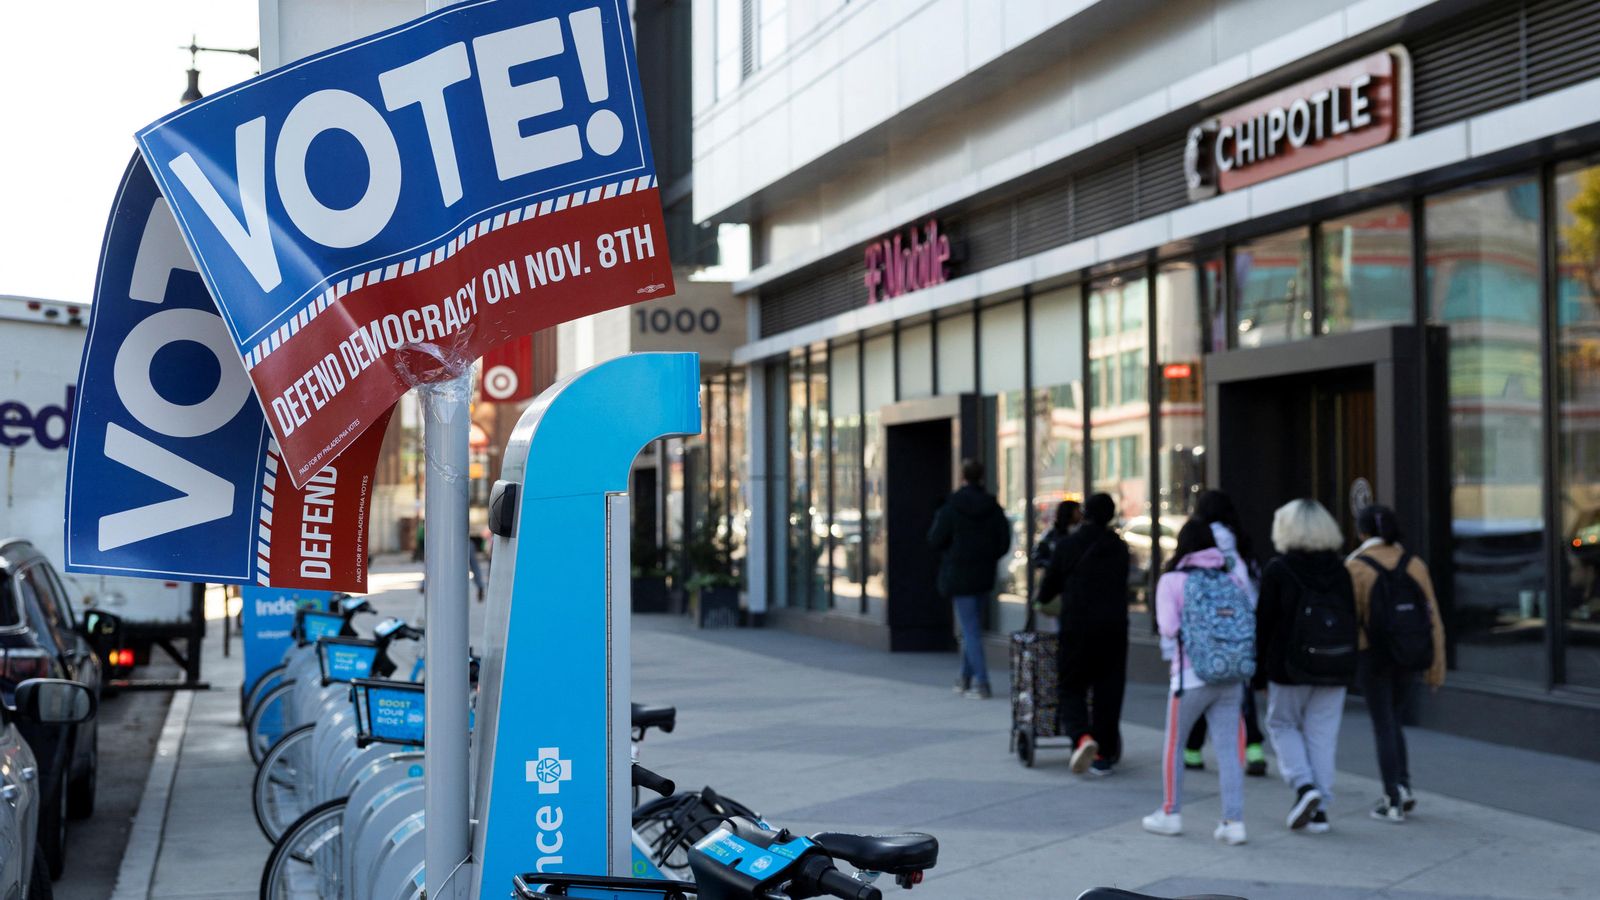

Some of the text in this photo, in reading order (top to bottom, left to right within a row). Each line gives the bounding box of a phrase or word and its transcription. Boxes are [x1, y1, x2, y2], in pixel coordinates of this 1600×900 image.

[168, 6, 624, 293] VOTE!
[1215, 74, 1371, 172] CHIPOTLE
[272, 224, 655, 437] DEFEND DEMOCRACY ON NOV. 8TH
[635, 308, 720, 333] 1000
[299, 418, 360, 475] PAID FOR BY PHILADELPHIA VOTES
[300, 465, 337, 579] DEFEND
[255, 596, 322, 616] Inde
[536, 806, 563, 893] nce
